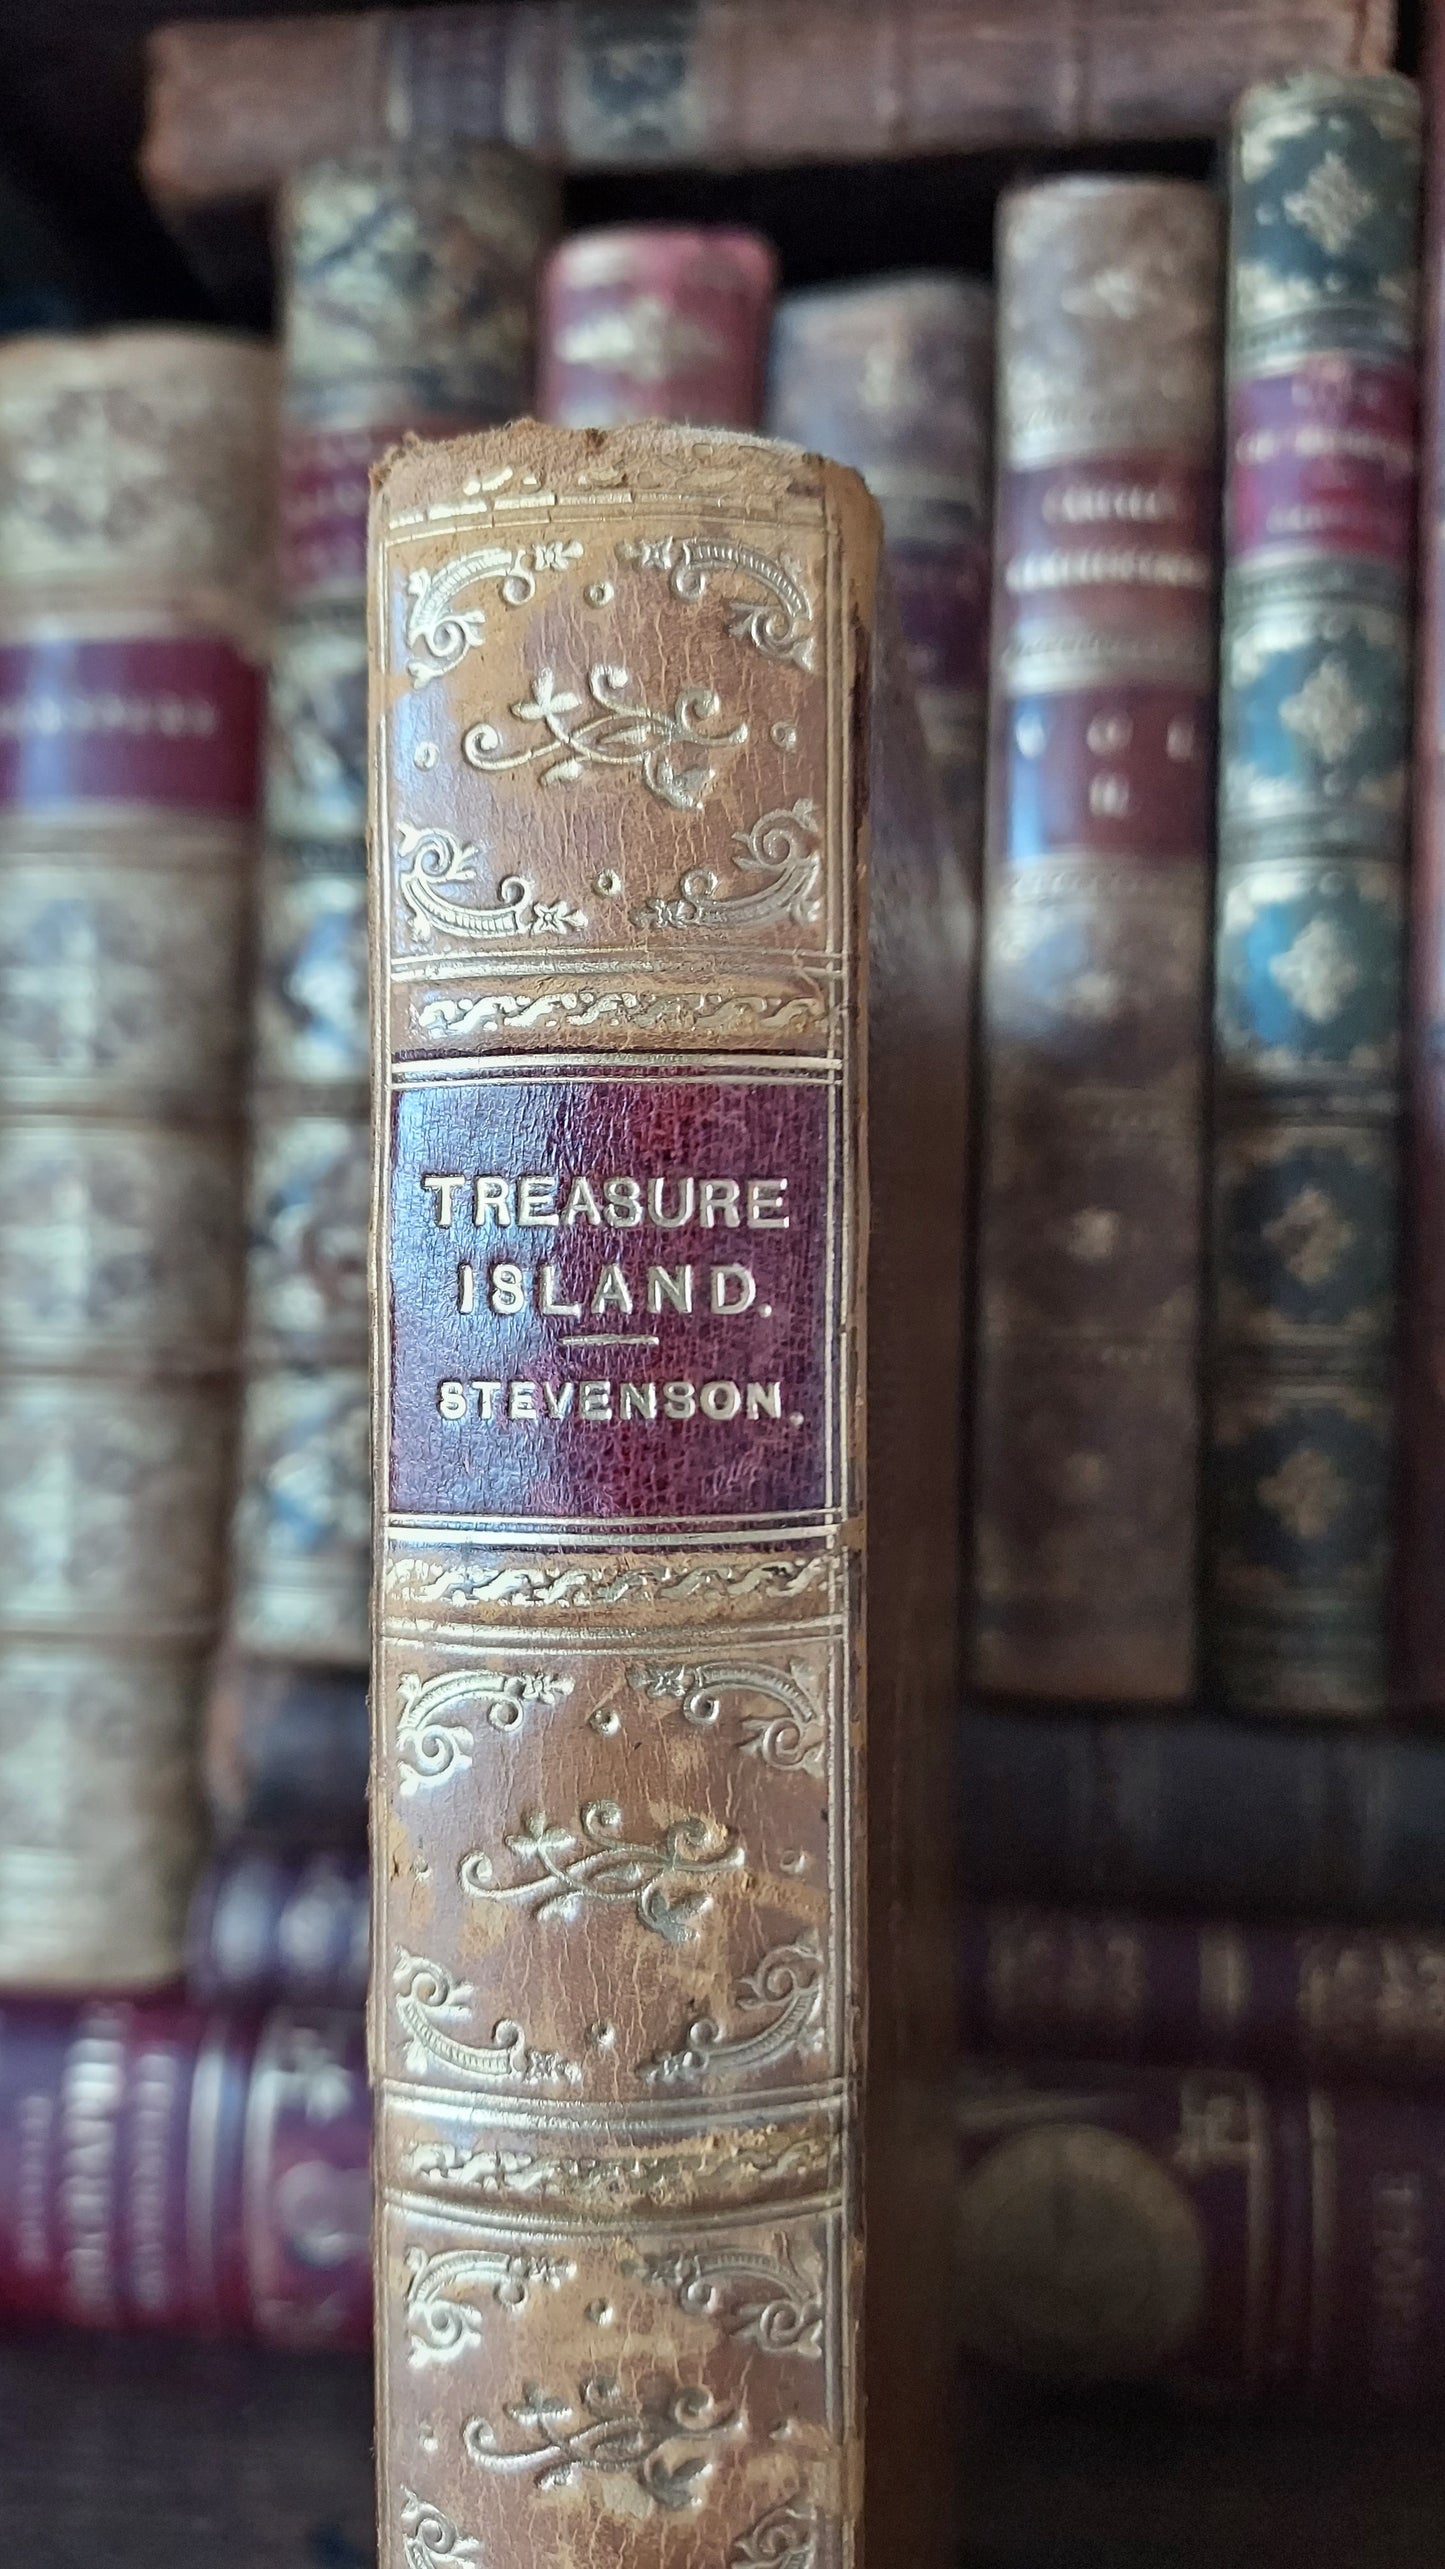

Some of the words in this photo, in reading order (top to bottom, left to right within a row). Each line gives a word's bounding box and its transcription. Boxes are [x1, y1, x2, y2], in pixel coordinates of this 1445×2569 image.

[422, 1173, 790, 1229] TREASURE
[457, 1262, 773, 1317] ISLAND.
[438, 1379, 805, 1427] STEVENSON.
